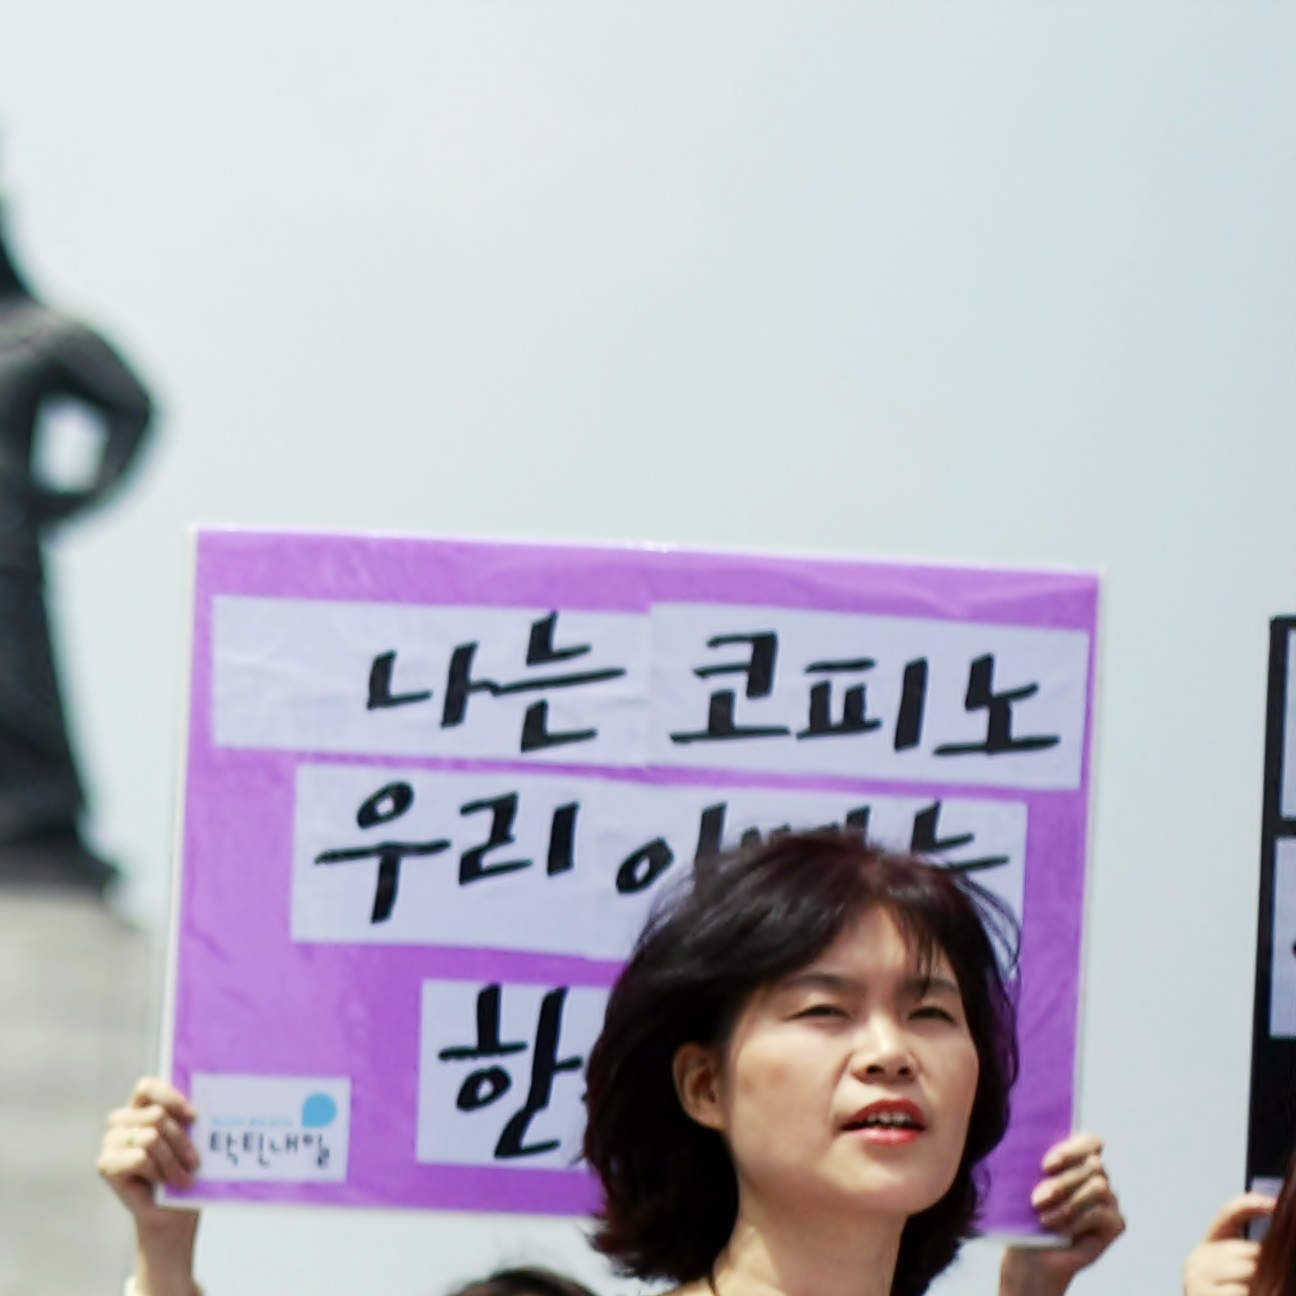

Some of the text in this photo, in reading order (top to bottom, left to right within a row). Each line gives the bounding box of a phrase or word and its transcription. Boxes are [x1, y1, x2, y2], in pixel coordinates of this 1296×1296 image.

[365, 610, 1061, 756] 나는 코피노
[313, 781, 581, 924] 우리
[438, 982, 592, 1161] 한
